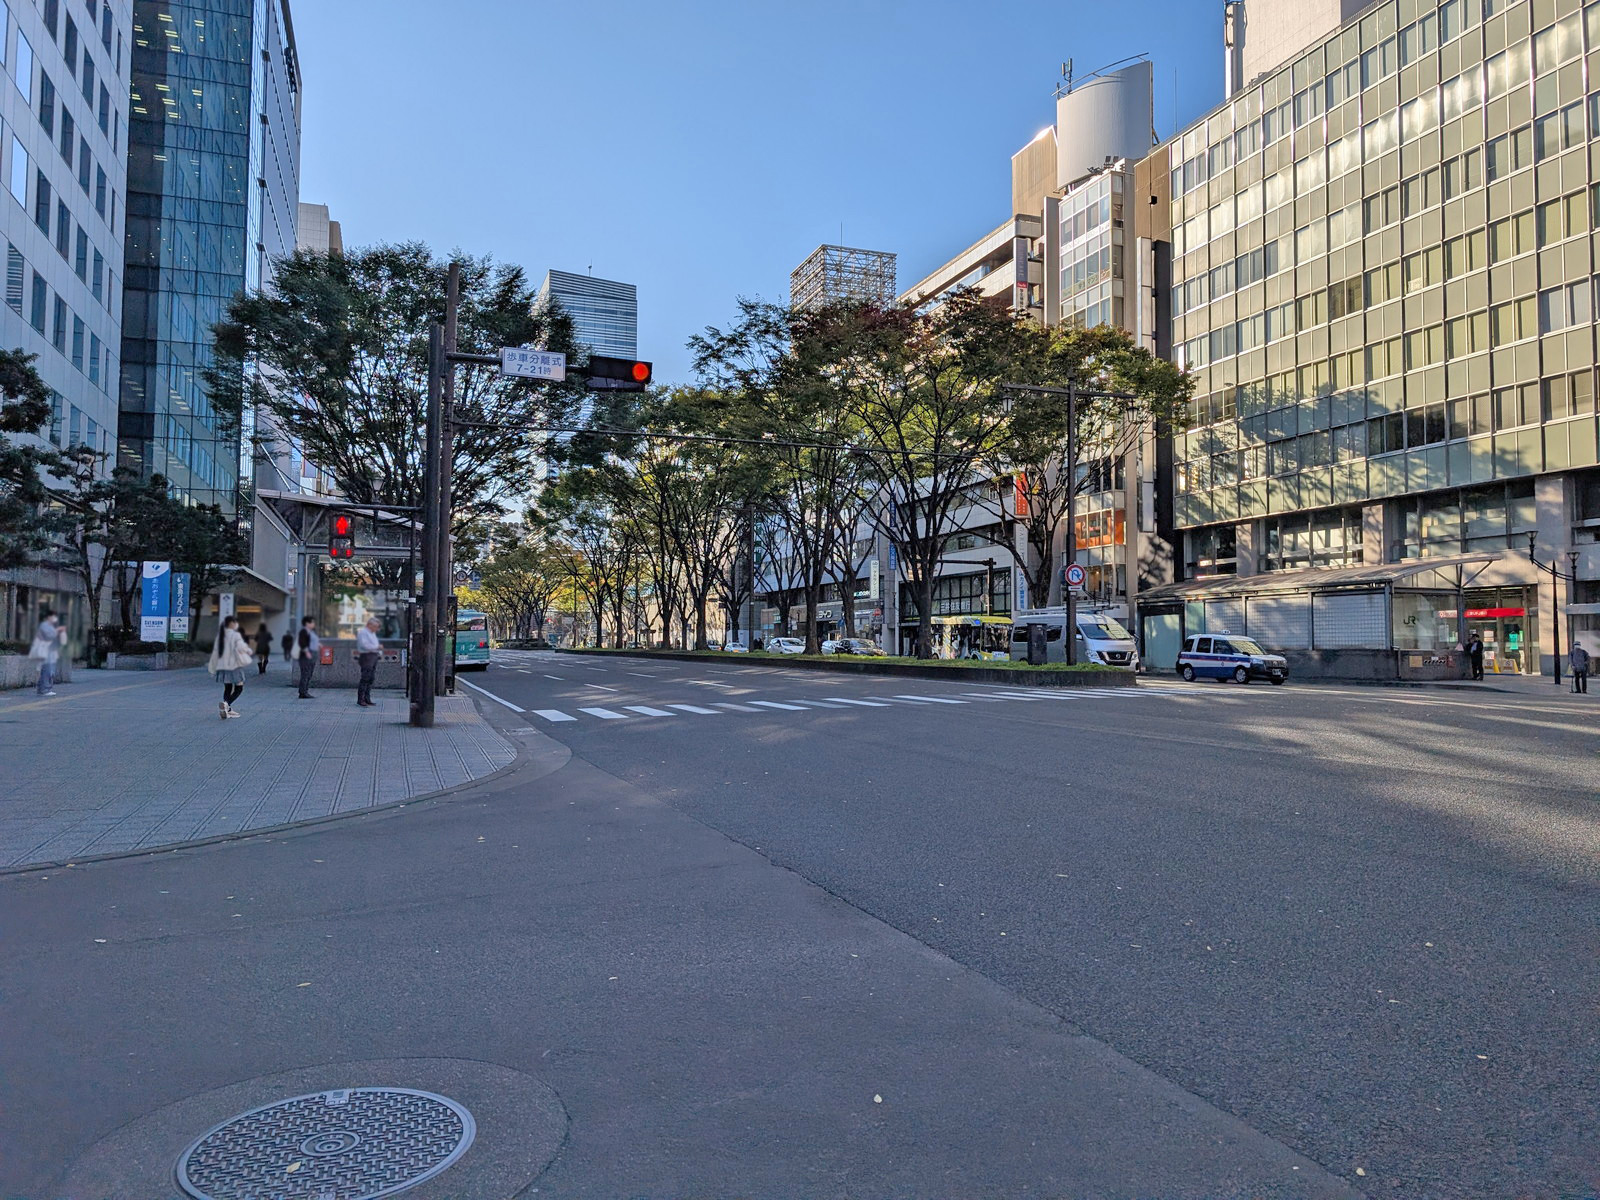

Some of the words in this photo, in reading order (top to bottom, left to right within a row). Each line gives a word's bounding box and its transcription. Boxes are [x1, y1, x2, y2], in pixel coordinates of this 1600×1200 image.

[507, 351, 561, 366] 歩車分離式
[151, 578, 159, 612] あおぞら銀行
[940, 600, 971, 612] 三井住友銀行
[1403, 615, 1416, 625] JR
